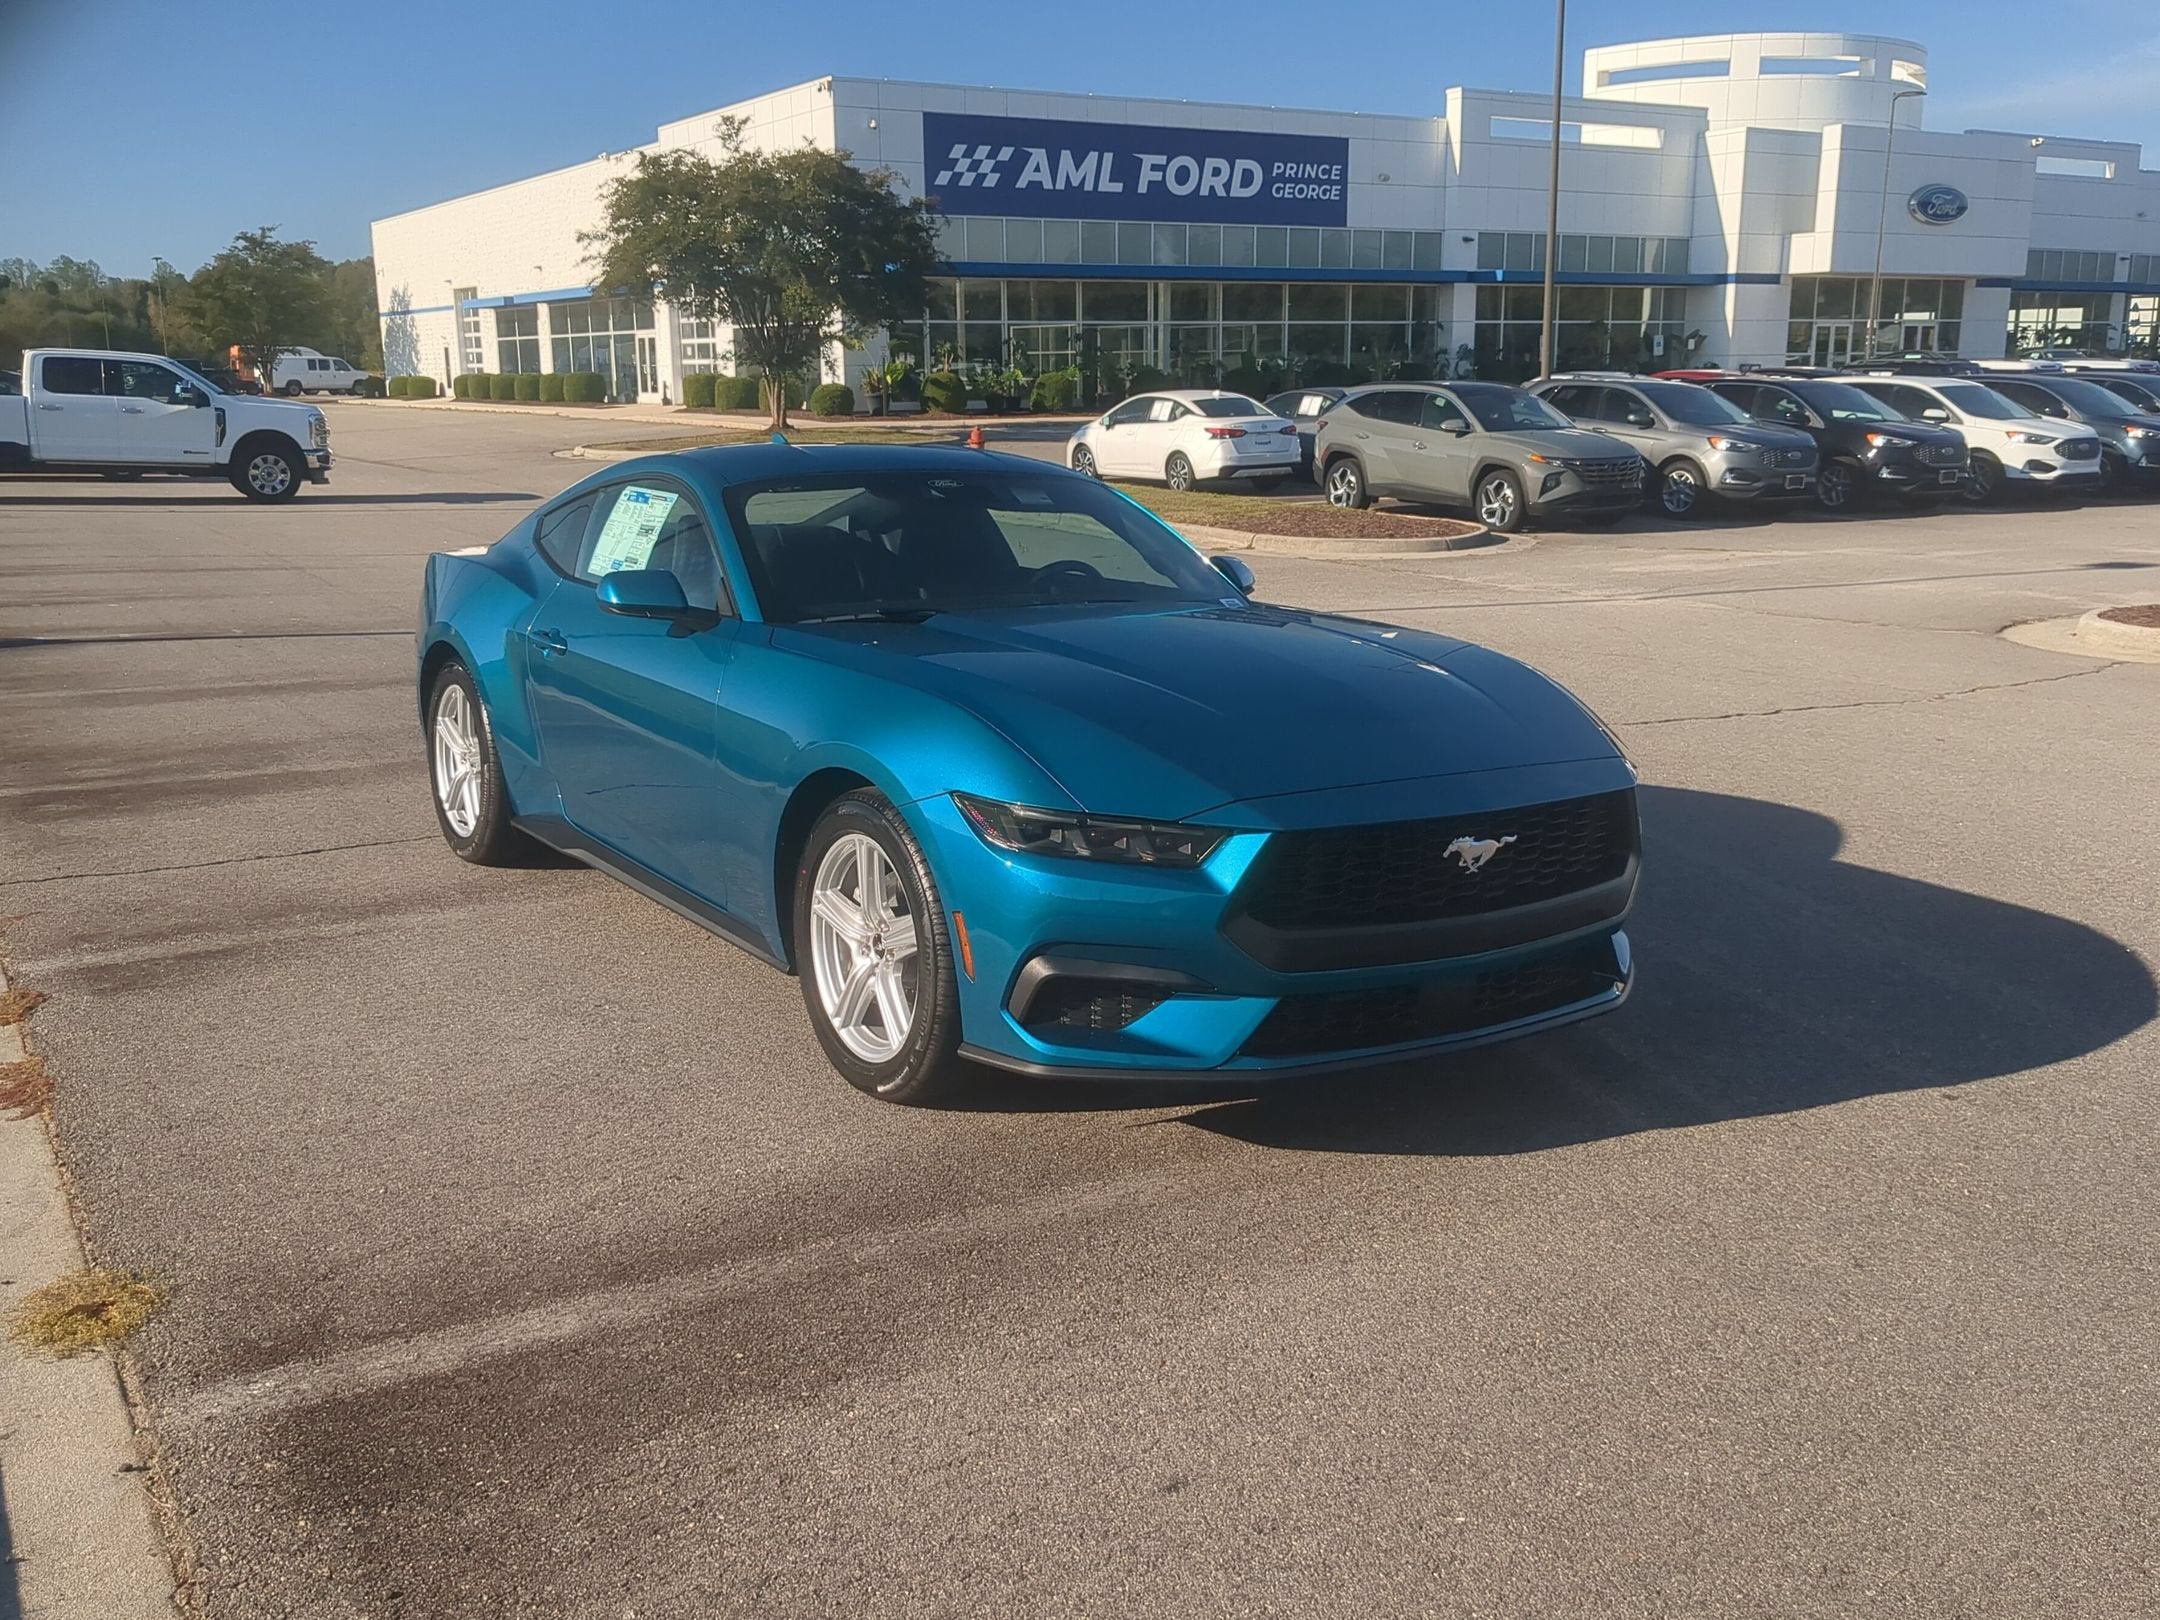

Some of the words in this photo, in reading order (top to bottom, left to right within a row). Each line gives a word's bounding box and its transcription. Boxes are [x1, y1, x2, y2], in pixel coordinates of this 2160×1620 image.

[1015, 147, 1124, 193] AML
[1133, 153, 1264, 198] FORD
[1272, 162, 1342, 180] PRINCE
[1271, 182, 1342, 200] GEORGE
[1927, 193, 1958, 215] Ford
